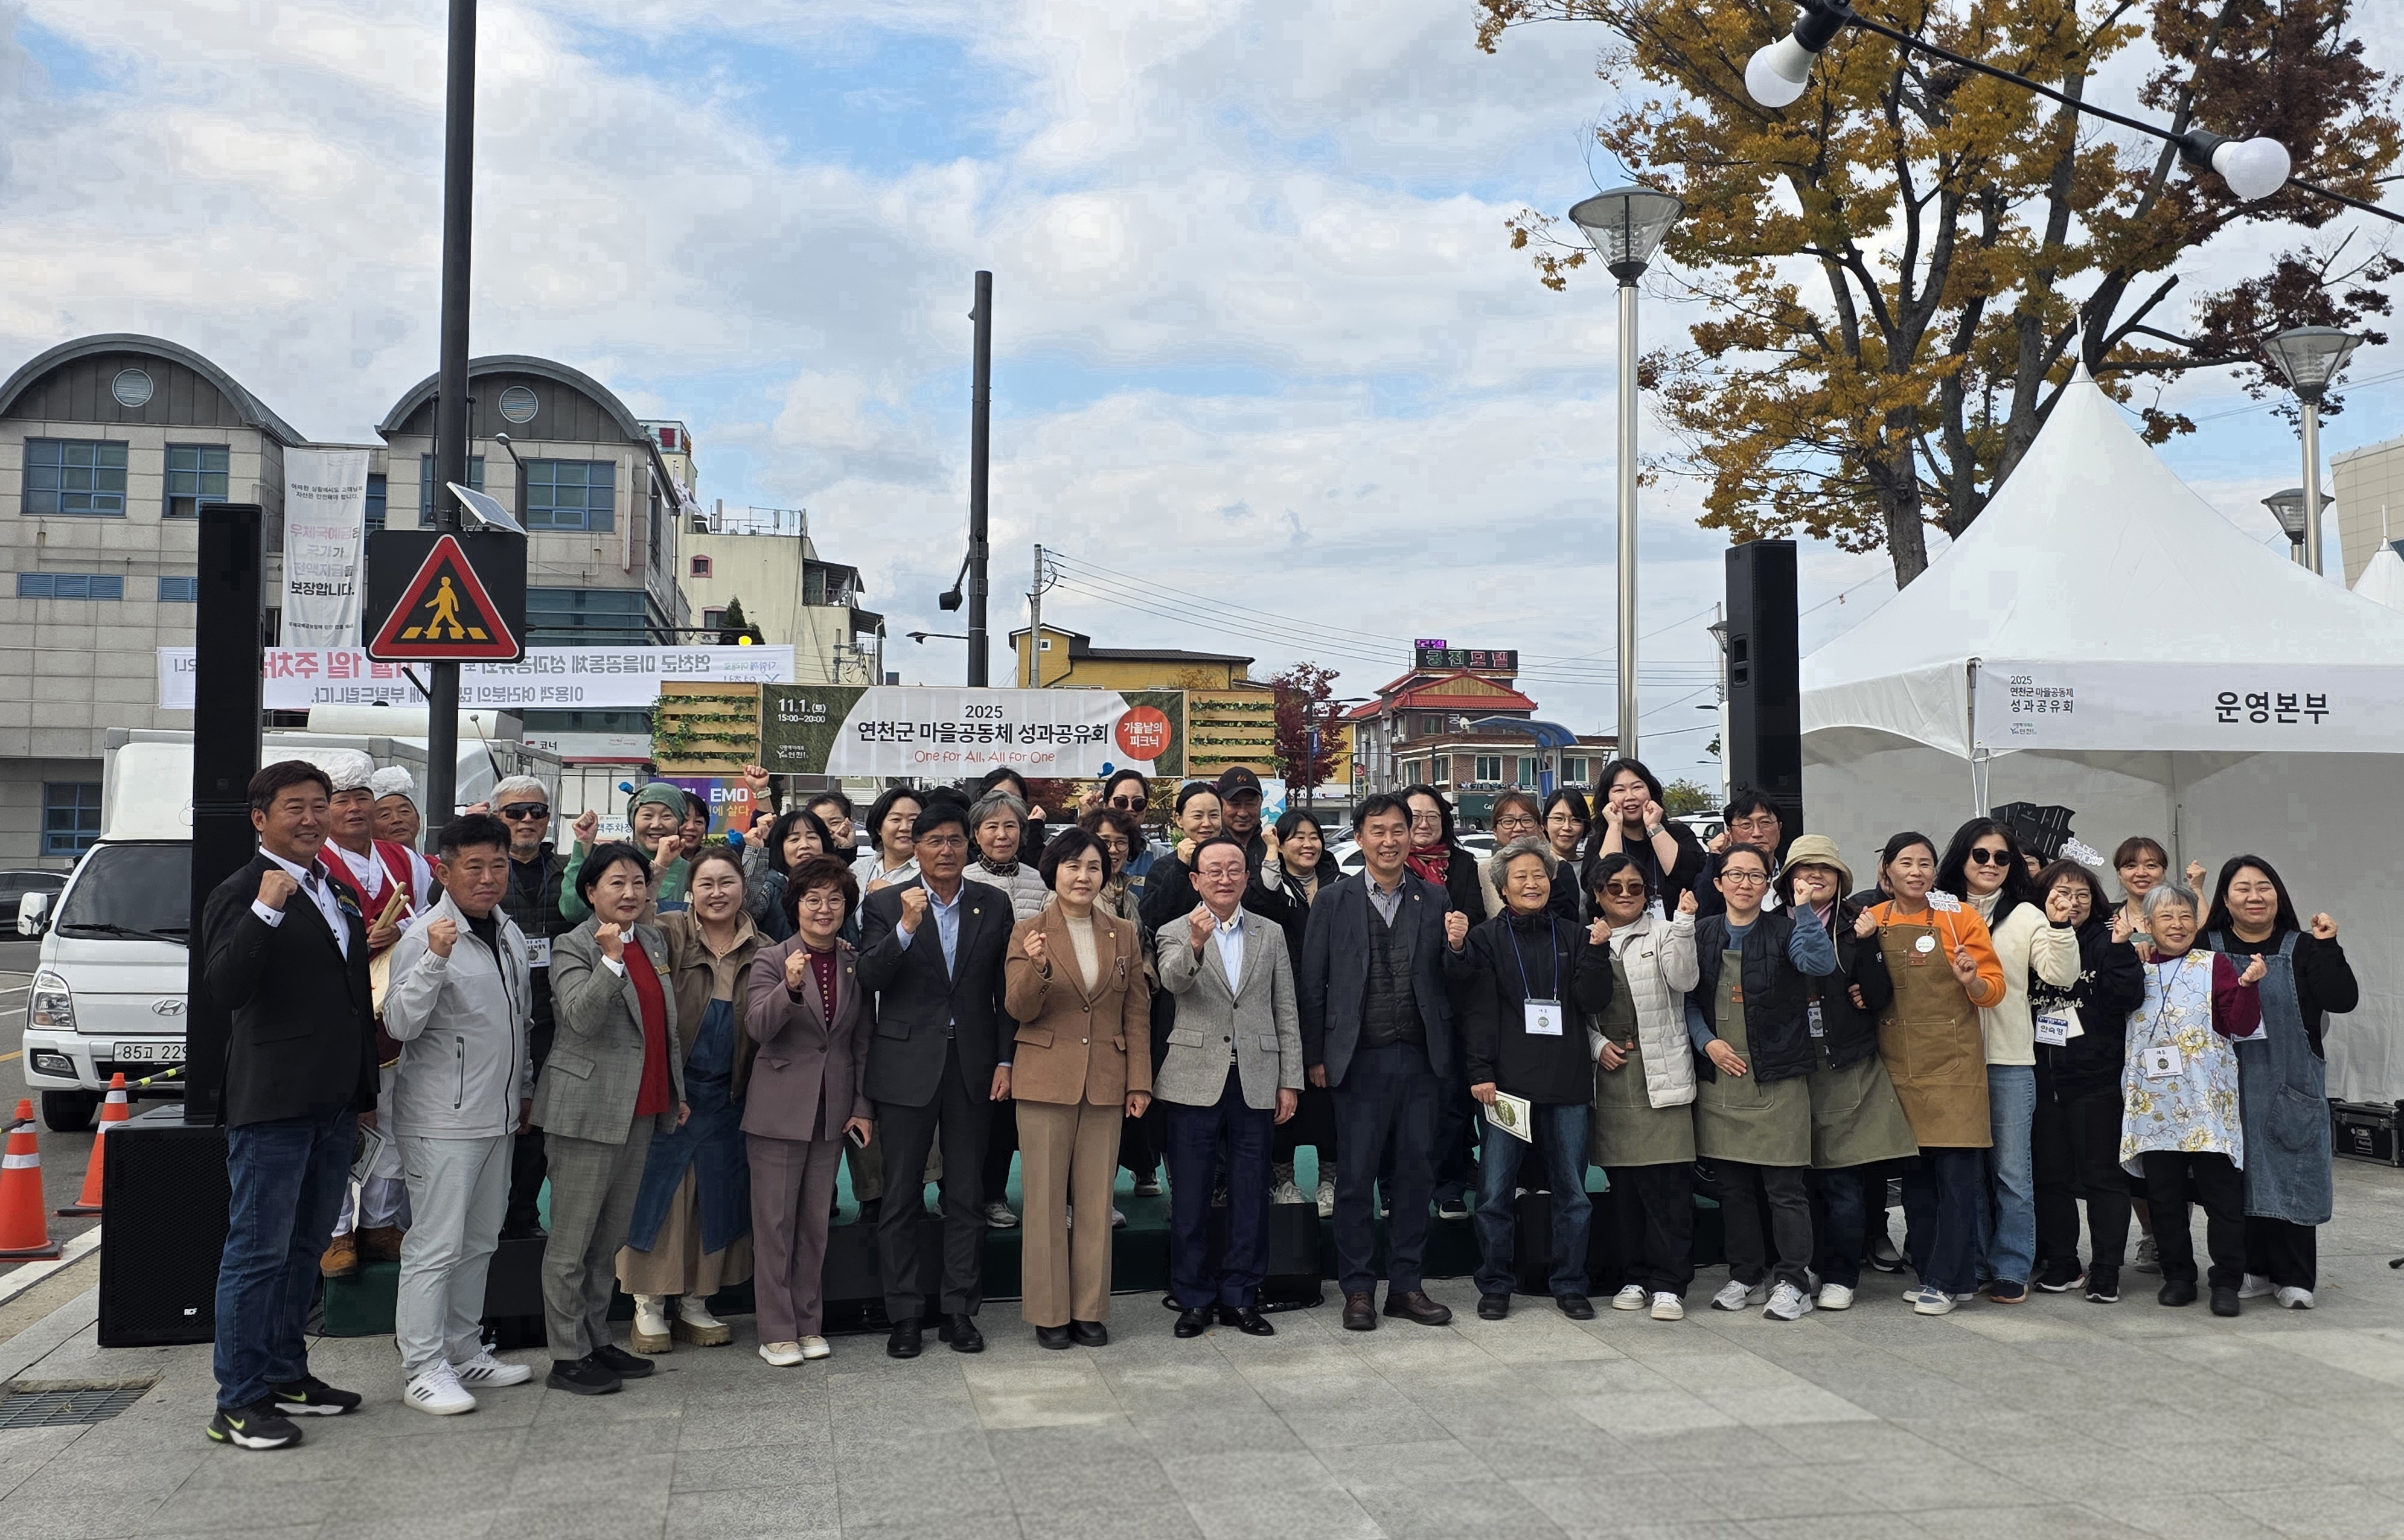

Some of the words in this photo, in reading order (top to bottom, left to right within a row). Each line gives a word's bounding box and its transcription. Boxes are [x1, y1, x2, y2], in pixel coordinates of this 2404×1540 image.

[290, 580, 355, 596] 보장합니다.
[1425, 650, 1509, 668] 궁전모텔
[2010, 676, 2033, 685] 2025
[2010, 687, 2035, 697] 연천군
[2035, 687, 2074, 698] 마을공동체
[965, 705, 1003, 719] 2025
[2010, 699, 2074, 714] 성과공유회
[2214, 691, 2330, 725] 운영본부
[857, 721, 915, 743] 연천군
[919, 722, 1013, 744] 마을공동체
[1017, 724, 1109, 745] 성과공유회
[1124, 721, 1163, 734] 가을날의
[540, 741, 557, 750] 코너
[1130, 735, 1159, 748] 피크닉
[914, 750, 939, 763] One
[942, 750, 961, 762] for
[964, 750, 985, 763] All,
[988, 750, 1006, 762] All
[1009, 751, 1027, 762] for
[1030, 752, 1055, 764] One
[710, 788, 749, 802] EMO
[726, 805, 750, 817] 살다
[123, 1046, 153, 1059] 85고
